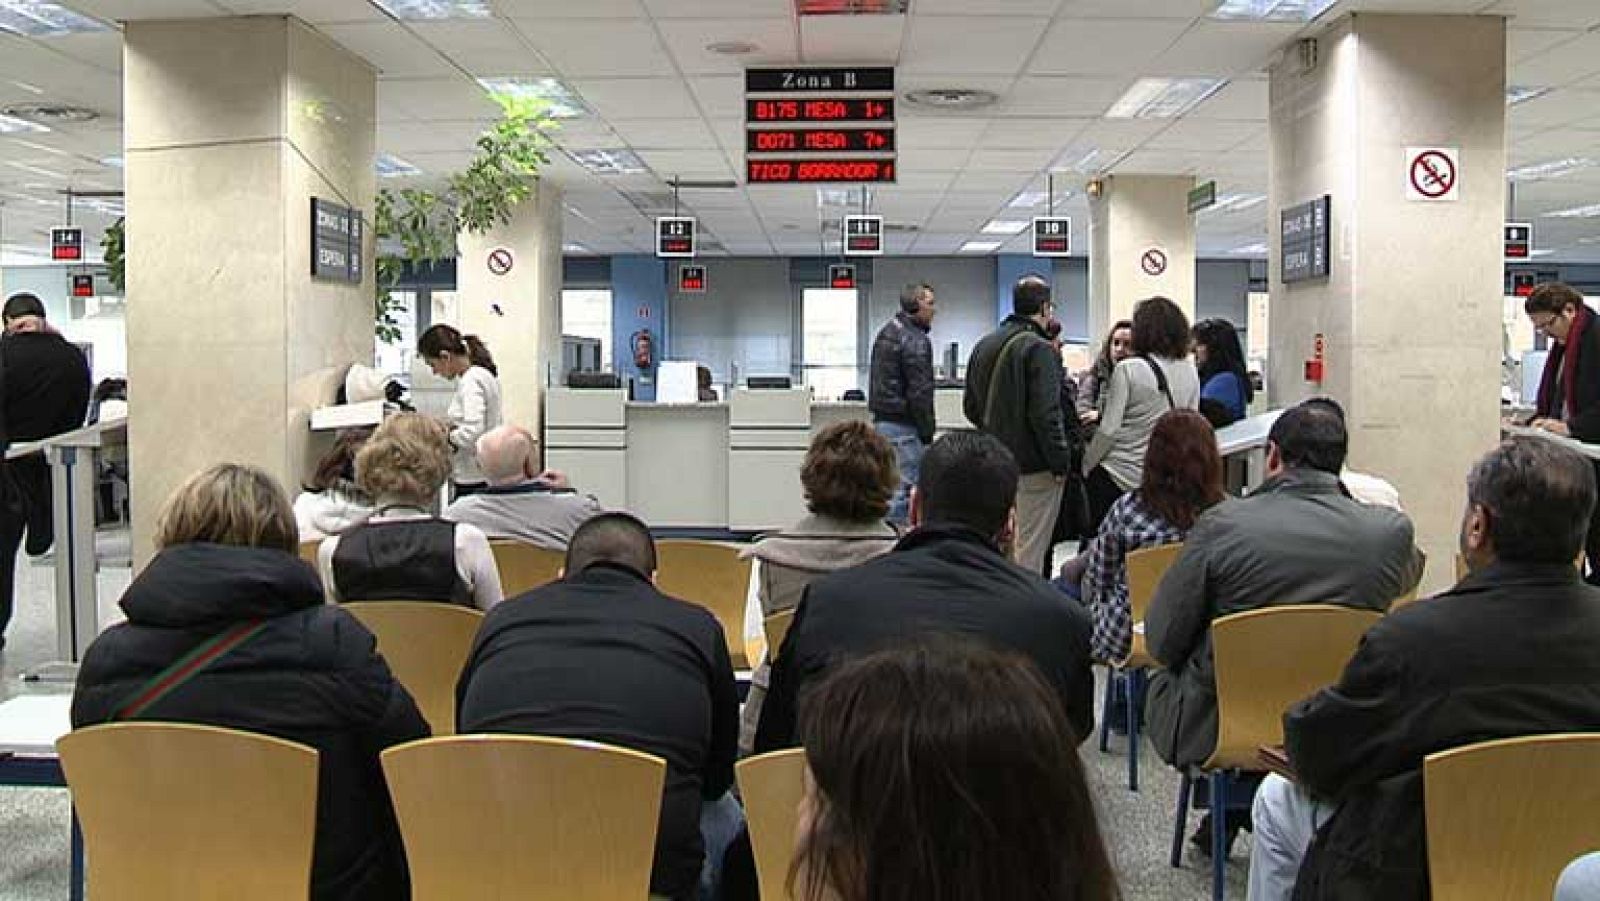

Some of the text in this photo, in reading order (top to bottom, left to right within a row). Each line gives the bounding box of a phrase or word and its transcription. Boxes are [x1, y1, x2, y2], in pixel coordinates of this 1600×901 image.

[782, 72, 857, 88] Zona B
[804, 101, 847, 118] MESA
[804, 132, 847, 149] MESA
[1045, 221, 1059, 234] 10
